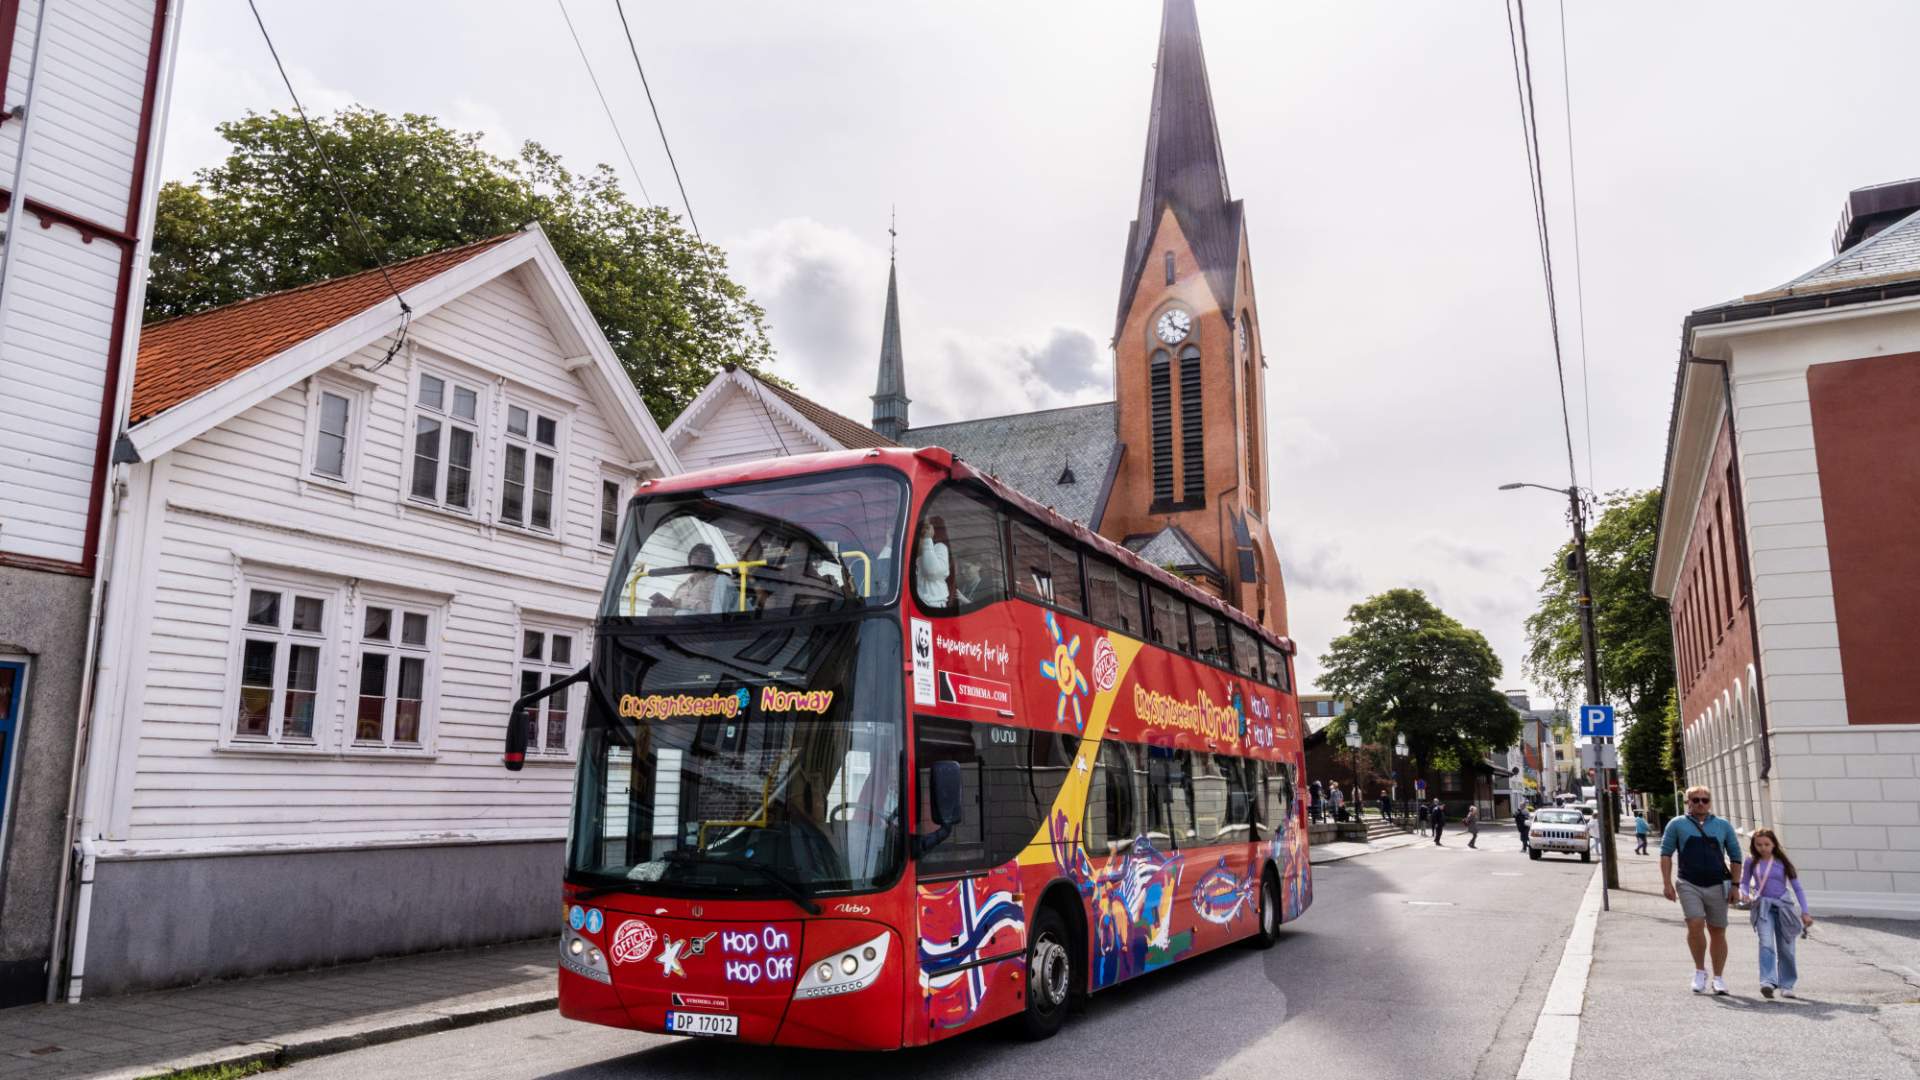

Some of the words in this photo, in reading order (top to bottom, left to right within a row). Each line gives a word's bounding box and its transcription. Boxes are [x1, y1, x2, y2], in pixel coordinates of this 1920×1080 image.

[760, 686, 833, 714] Norway
[1588, 709, 1605, 733] P
[615, 929, 655, 957] OFFICIAL
[723, 931, 758, 954] Hop
[763, 927, 789, 950] On
[726, 961, 761, 983] Hop
[766, 957, 794, 980] Off
[677, 1014, 694, 1030] DP
[698, 1015, 733, 1033] 17012
